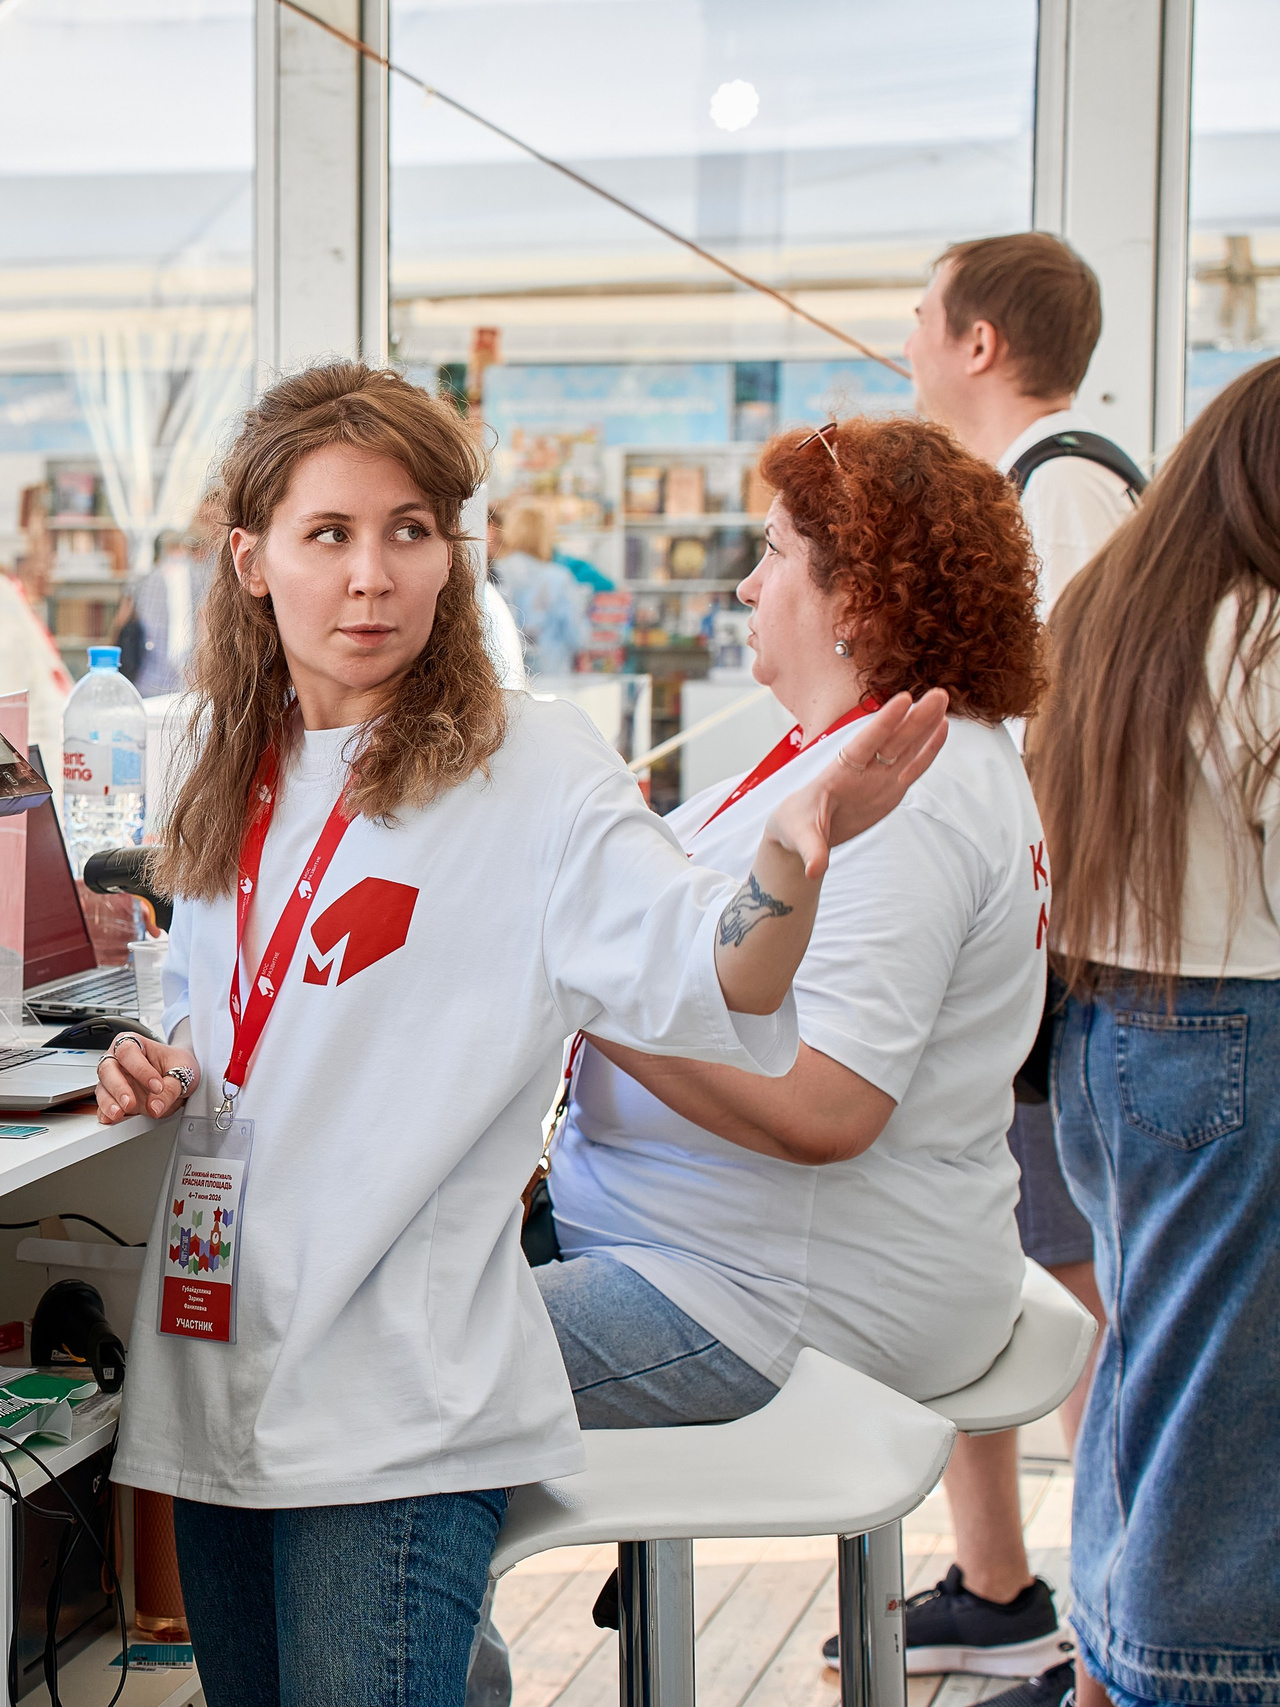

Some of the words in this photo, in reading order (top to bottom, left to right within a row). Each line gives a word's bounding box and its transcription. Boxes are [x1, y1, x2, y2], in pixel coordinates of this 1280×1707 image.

[181, 1178, 205, 1187] КРАСНАЯ
[205, 1180, 233, 1190] ПЛОЩАДЬ
[175, 1317, 214, 1332] УЧАСТНИК
